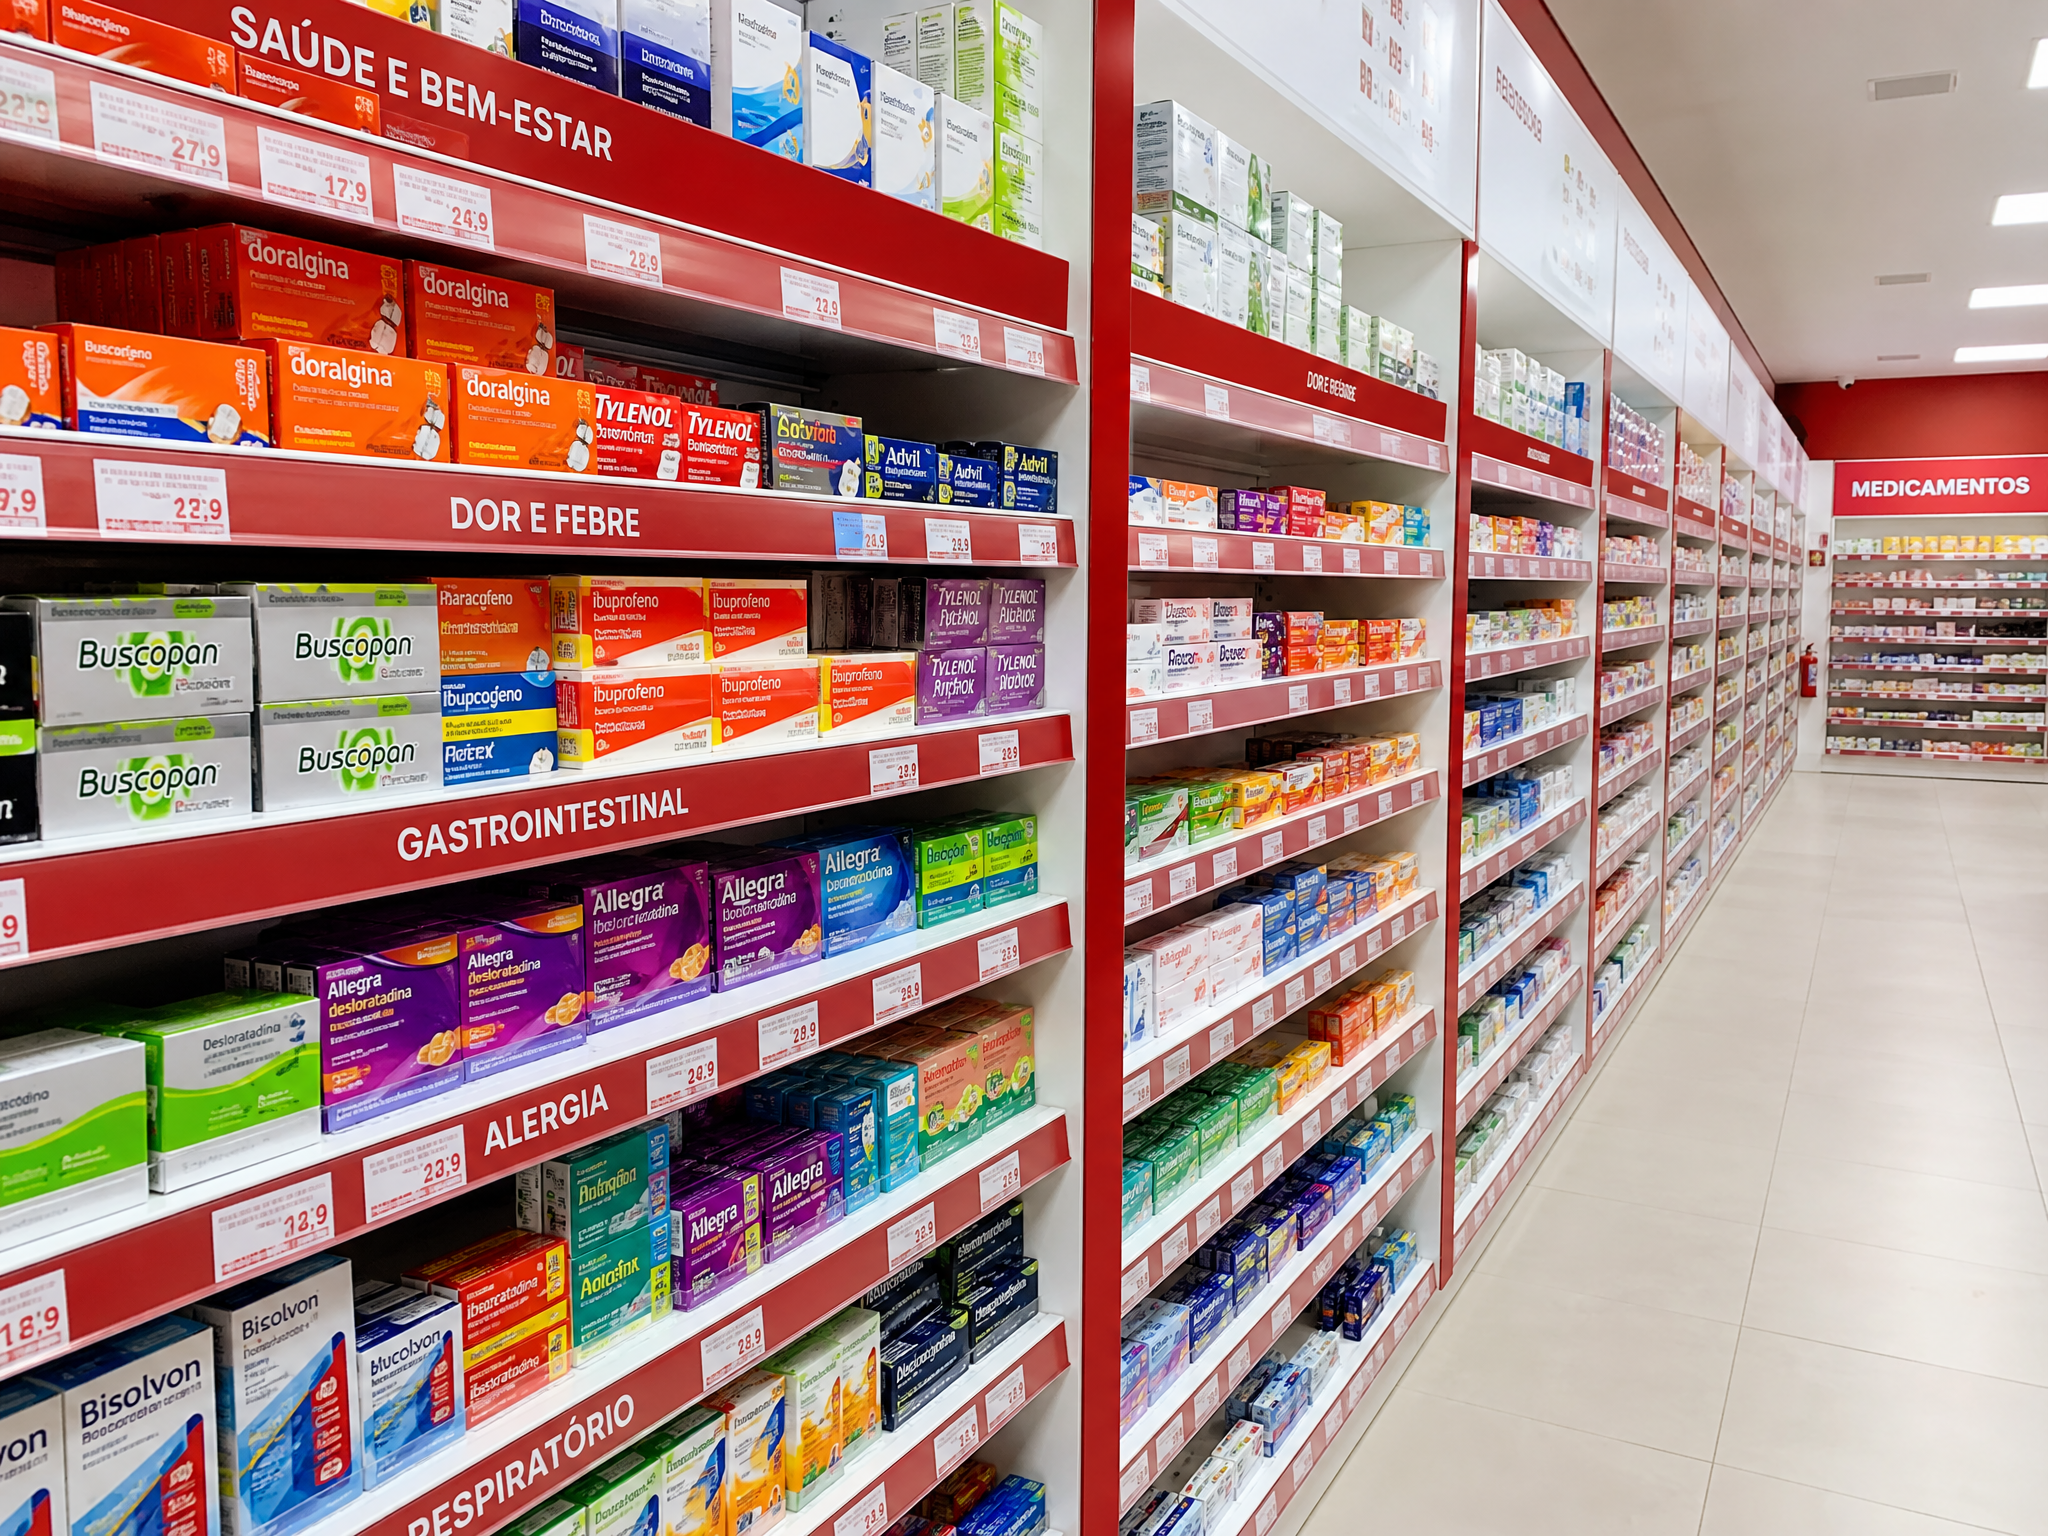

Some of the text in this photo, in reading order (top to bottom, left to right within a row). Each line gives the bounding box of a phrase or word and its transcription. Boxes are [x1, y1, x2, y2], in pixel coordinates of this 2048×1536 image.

[230, 6, 377, 88] SAÚDE
[388, 61, 409, 98] E
[420, 67, 613, 162] BEM-ESTAR
[171, 136, 221, 167] 27,9
[325, 175, 367, 203] 17,9
[247, 239, 350, 280] doralgina
[423, 268, 509, 310] doralgina
[290, 351, 393, 388] doralgina
[466, 370, 551, 406] doralgina
[596, 394, 675, 428] TYLENOL
[688, 412, 754, 442] TYLENOL
[885, 447, 921, 469] Advil
[1851, 476, 2031, 498] MEDICAMENTOS
[450, 496, 641, 538] DOR E FEBRE
[593, 591, 659, 613] ibuprofeno
[938, 586, 982, 607] TYLENOL
[79, 640, 219, 673] Buscopan
[296, 633, 412, 664] Buscopan
[593, 682, 665, 706] ibuprofeno
[721, 675, 783, 696] ibuprofeno
[299, 743, 415, 774] Buscopan
[79, 765, 217, 798] Buscopan
[397, 787, 690, 862] GASTROINTESTINAL
[593, 882, 665, 915] Allegra
[722, 870, 788, 904] Allegra
[467, 948, 515, 970] Allegra
[327, 972, 382, 1000] Allegra
[329, 983, 413, 1019] desloratadina
[203, 1021, 282, 1052] Desloratadina
[793, 1021, 816, 1044] 28,9
[483, 1083, 609, 1157] ALERGIA
[772, 1160, 824, 1202] Allegra
[242, 1292, 320, 1341] Bisolvon
[737, 1328, 762, 1355] 28,9
[79, 1358, 202, 1431] Bisolvon
